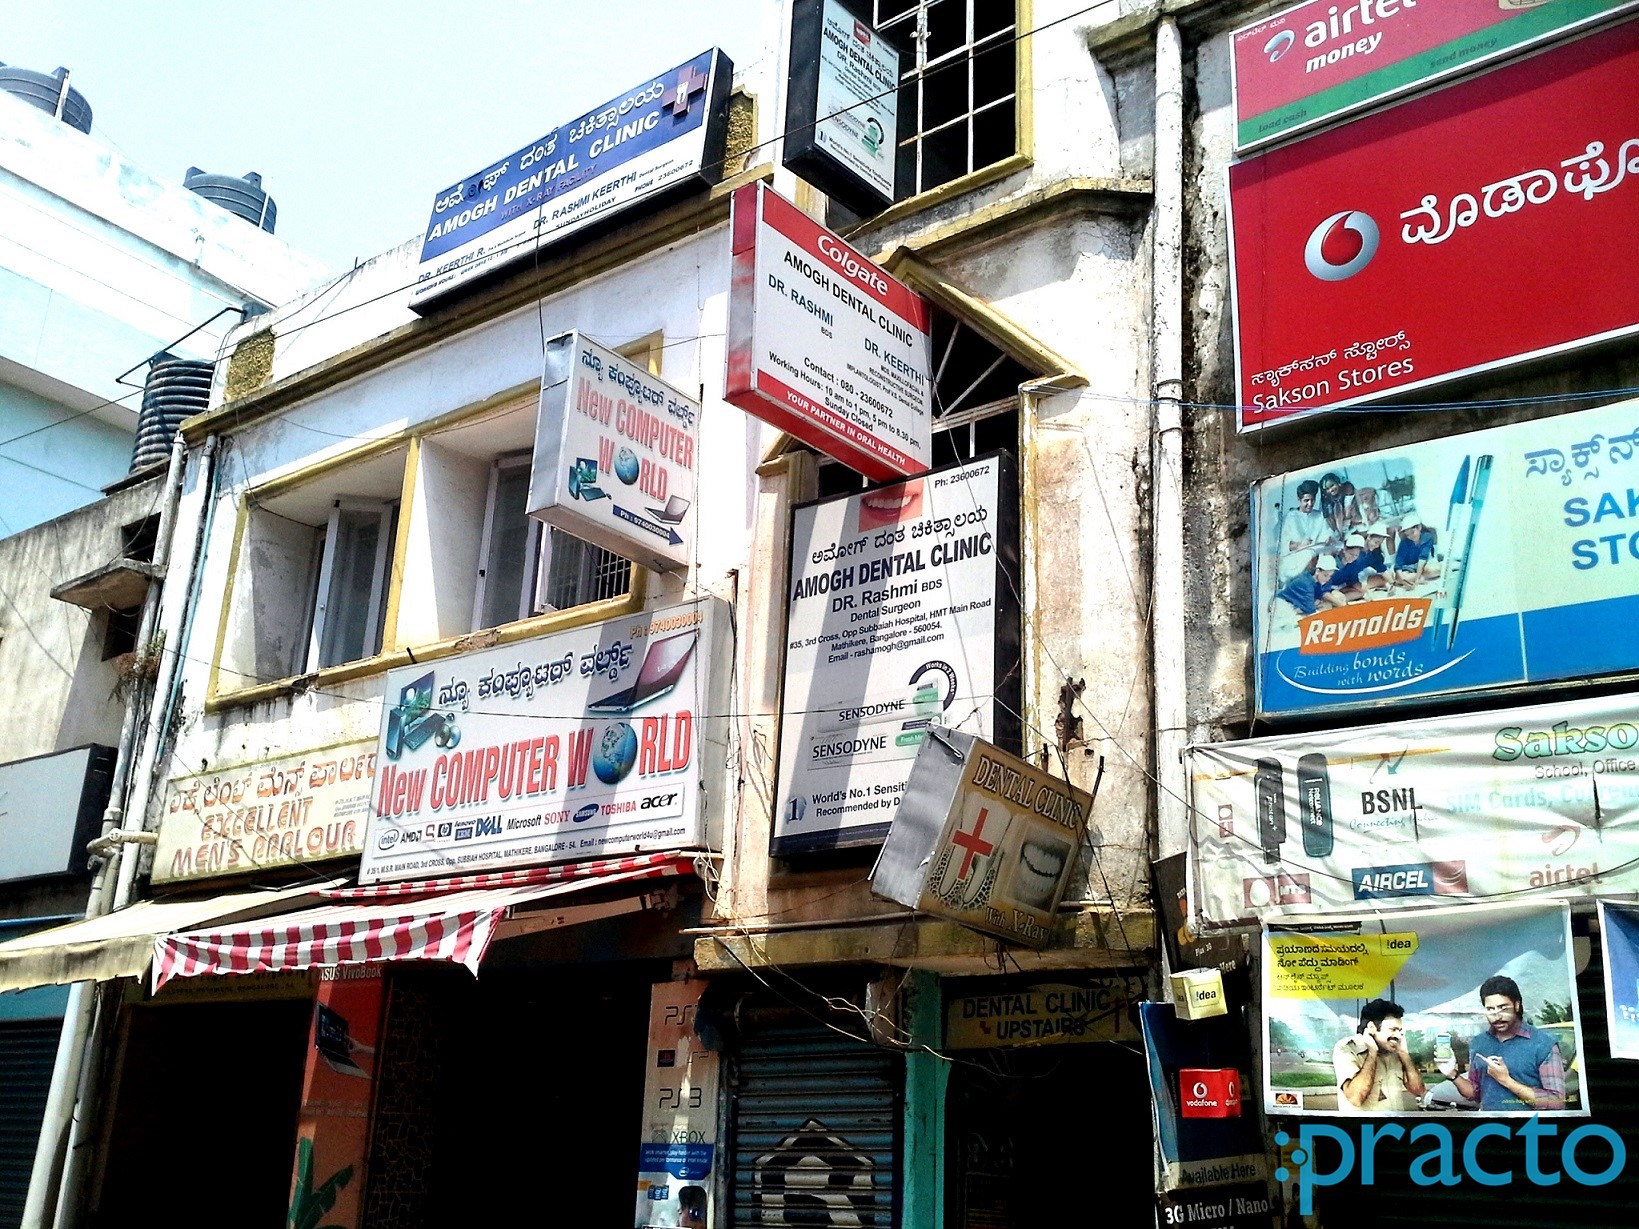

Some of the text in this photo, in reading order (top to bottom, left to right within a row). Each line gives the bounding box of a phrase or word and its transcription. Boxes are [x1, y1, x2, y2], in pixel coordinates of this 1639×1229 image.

[1304, 0, 1416, 47] airte
[1305, 32, 1382, 73] money
[428, 194, 499, 242] AMOGH
[503, 153, 579, 205] DENTAL
[588, 110, 660, 159] CLINIC
[551, 195, 590, 220] RASHMI
[591, 171, 637, 200] KEERTHI
[816, 234, 889, 296] Colgate
[768, 273, 834, 328] DR. RASHMI
[784, 250, 914, 348] AMOGH DENTAL CLINIC
[864, 338, 924, 387] DR. KEERTHI
[768, 350, 799, 378] Working
[799, 369, 824, 392] Hours:
[825, 384, 834, 398] 10
[834, 392, 845, 404] am
[845, 397, 854, 409] to
[877, 417, 888, 430] pm
[888, 423, 896, 435] to
[803, 356, 835, 382] Contact
[860, 391, 894, 419] 23600672
[1252, 357, 1414, 415] Sakson Stores
[576, 376, 694, 471] New COMPUTER
[786, 390, 906, 466] YOUR PARTNER IN ORAL HEALTH
[824, 396, 874, 431] Sunday Closed
[934, 465, 990, 489] Ph: 23600672
[792, 532, 992, 602] AMOGH DENTAL CLINIC
[832, 578, 943, 613] DR. Rashmi BDS
[850, 598, 921, 623] Dental Surgeon
[804, 636, 817, 647] 3rd
[817, 631, 841, 645] Cross,
[841, 627, 858, 640] Opp
[894, 613, 928, 630] Hospital,
[929, 607, 948, 619] HMT
[949, 602, 969, 614] Main
[969, 597, 992, 610] Road
[830, 621, 943, 653] Mathikere, Bangalore 560054.
[1304, 604, 1424, 647] Reynolds
[828, 632, 945, 664] Email rashamogh@gmail.com
[1294, 648, 1406, 680] Building bonds
[1337, 661, 1424, 687] with words
[838, 699, 906, 722] SENSODYNE
[812, 736, 888, 759] SENSODYNE
[1492, 720, 1639, 762] Sakso
[376, 763, 428, 818] New
[429, 733, 560, 810] COMPUTER
[1534, 758, 1636, 780] School, Office
[811, 786, 871, 805] World's No.1
[816, 800, 892, 818] Recommended by
[972, 756, 1084, 830] DENTAL CLINIC
[1361, 787, 1423, 815] BSNL
[1446, 791, 1482, 813] SIM
[201, 795, 314, 842] EXCELLENT
[475, 815, 503, 838] DELL
[506, 814, 542, 831] Microsoft
[543, 810, 571, 826] SONY
[600, 800, 637, 817] TOSHIBA
[640, 791, 678, 811] acer
[1349, 814, 1407, 831] Connecting
[252, 819, 357, 862] PARLOUR
[533, 842, 565, 854] BANGALORE
[579, 838, 594, 848] Email
[1358, 870, 1429, 893] AIRCEL
[1529, 862, 1604, 888] airtel
[984, 905, 1048, 943] With X-Ray
[342, 965, 382, 980] VivoBook
[962, 989, 1112, 1020] DENTAL CLINIC
[996, 1017, 1087, 1041] UPSTAIRS
[659, 1087, 702, 1110] PS3
[1186, 1099, 1218, 1107] vodafone
[671, 1130, 707, 1144] XBOX
[1180, 1163, 1256, 1185] Available Here
[1164, 1197, 1269, 1225] 3G Micro Nano
